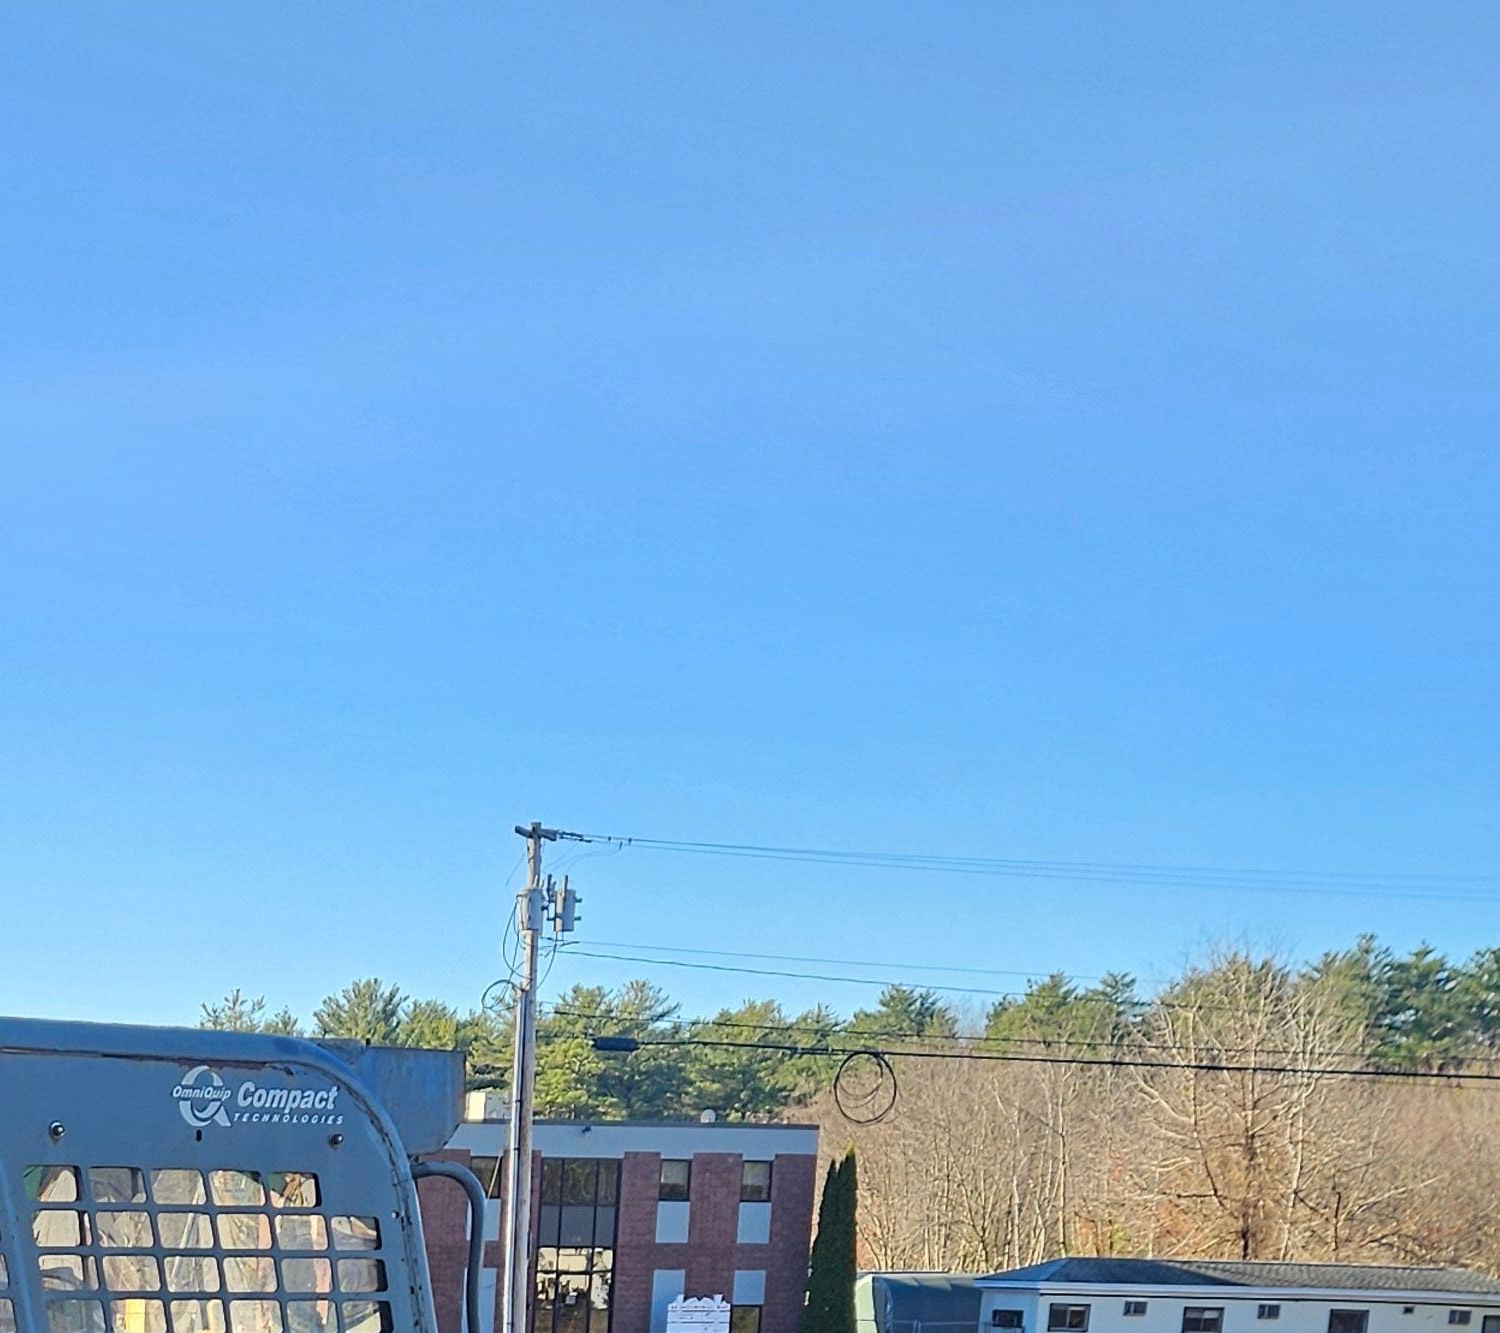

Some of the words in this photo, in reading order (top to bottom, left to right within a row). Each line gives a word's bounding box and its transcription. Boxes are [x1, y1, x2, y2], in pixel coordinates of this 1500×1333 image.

[172, 1085, 232, 1100] OmniQuip
[237, 1081, 338, 1113] Compact
[233, 1112, 344, 1125] TECHNOLOGIES
